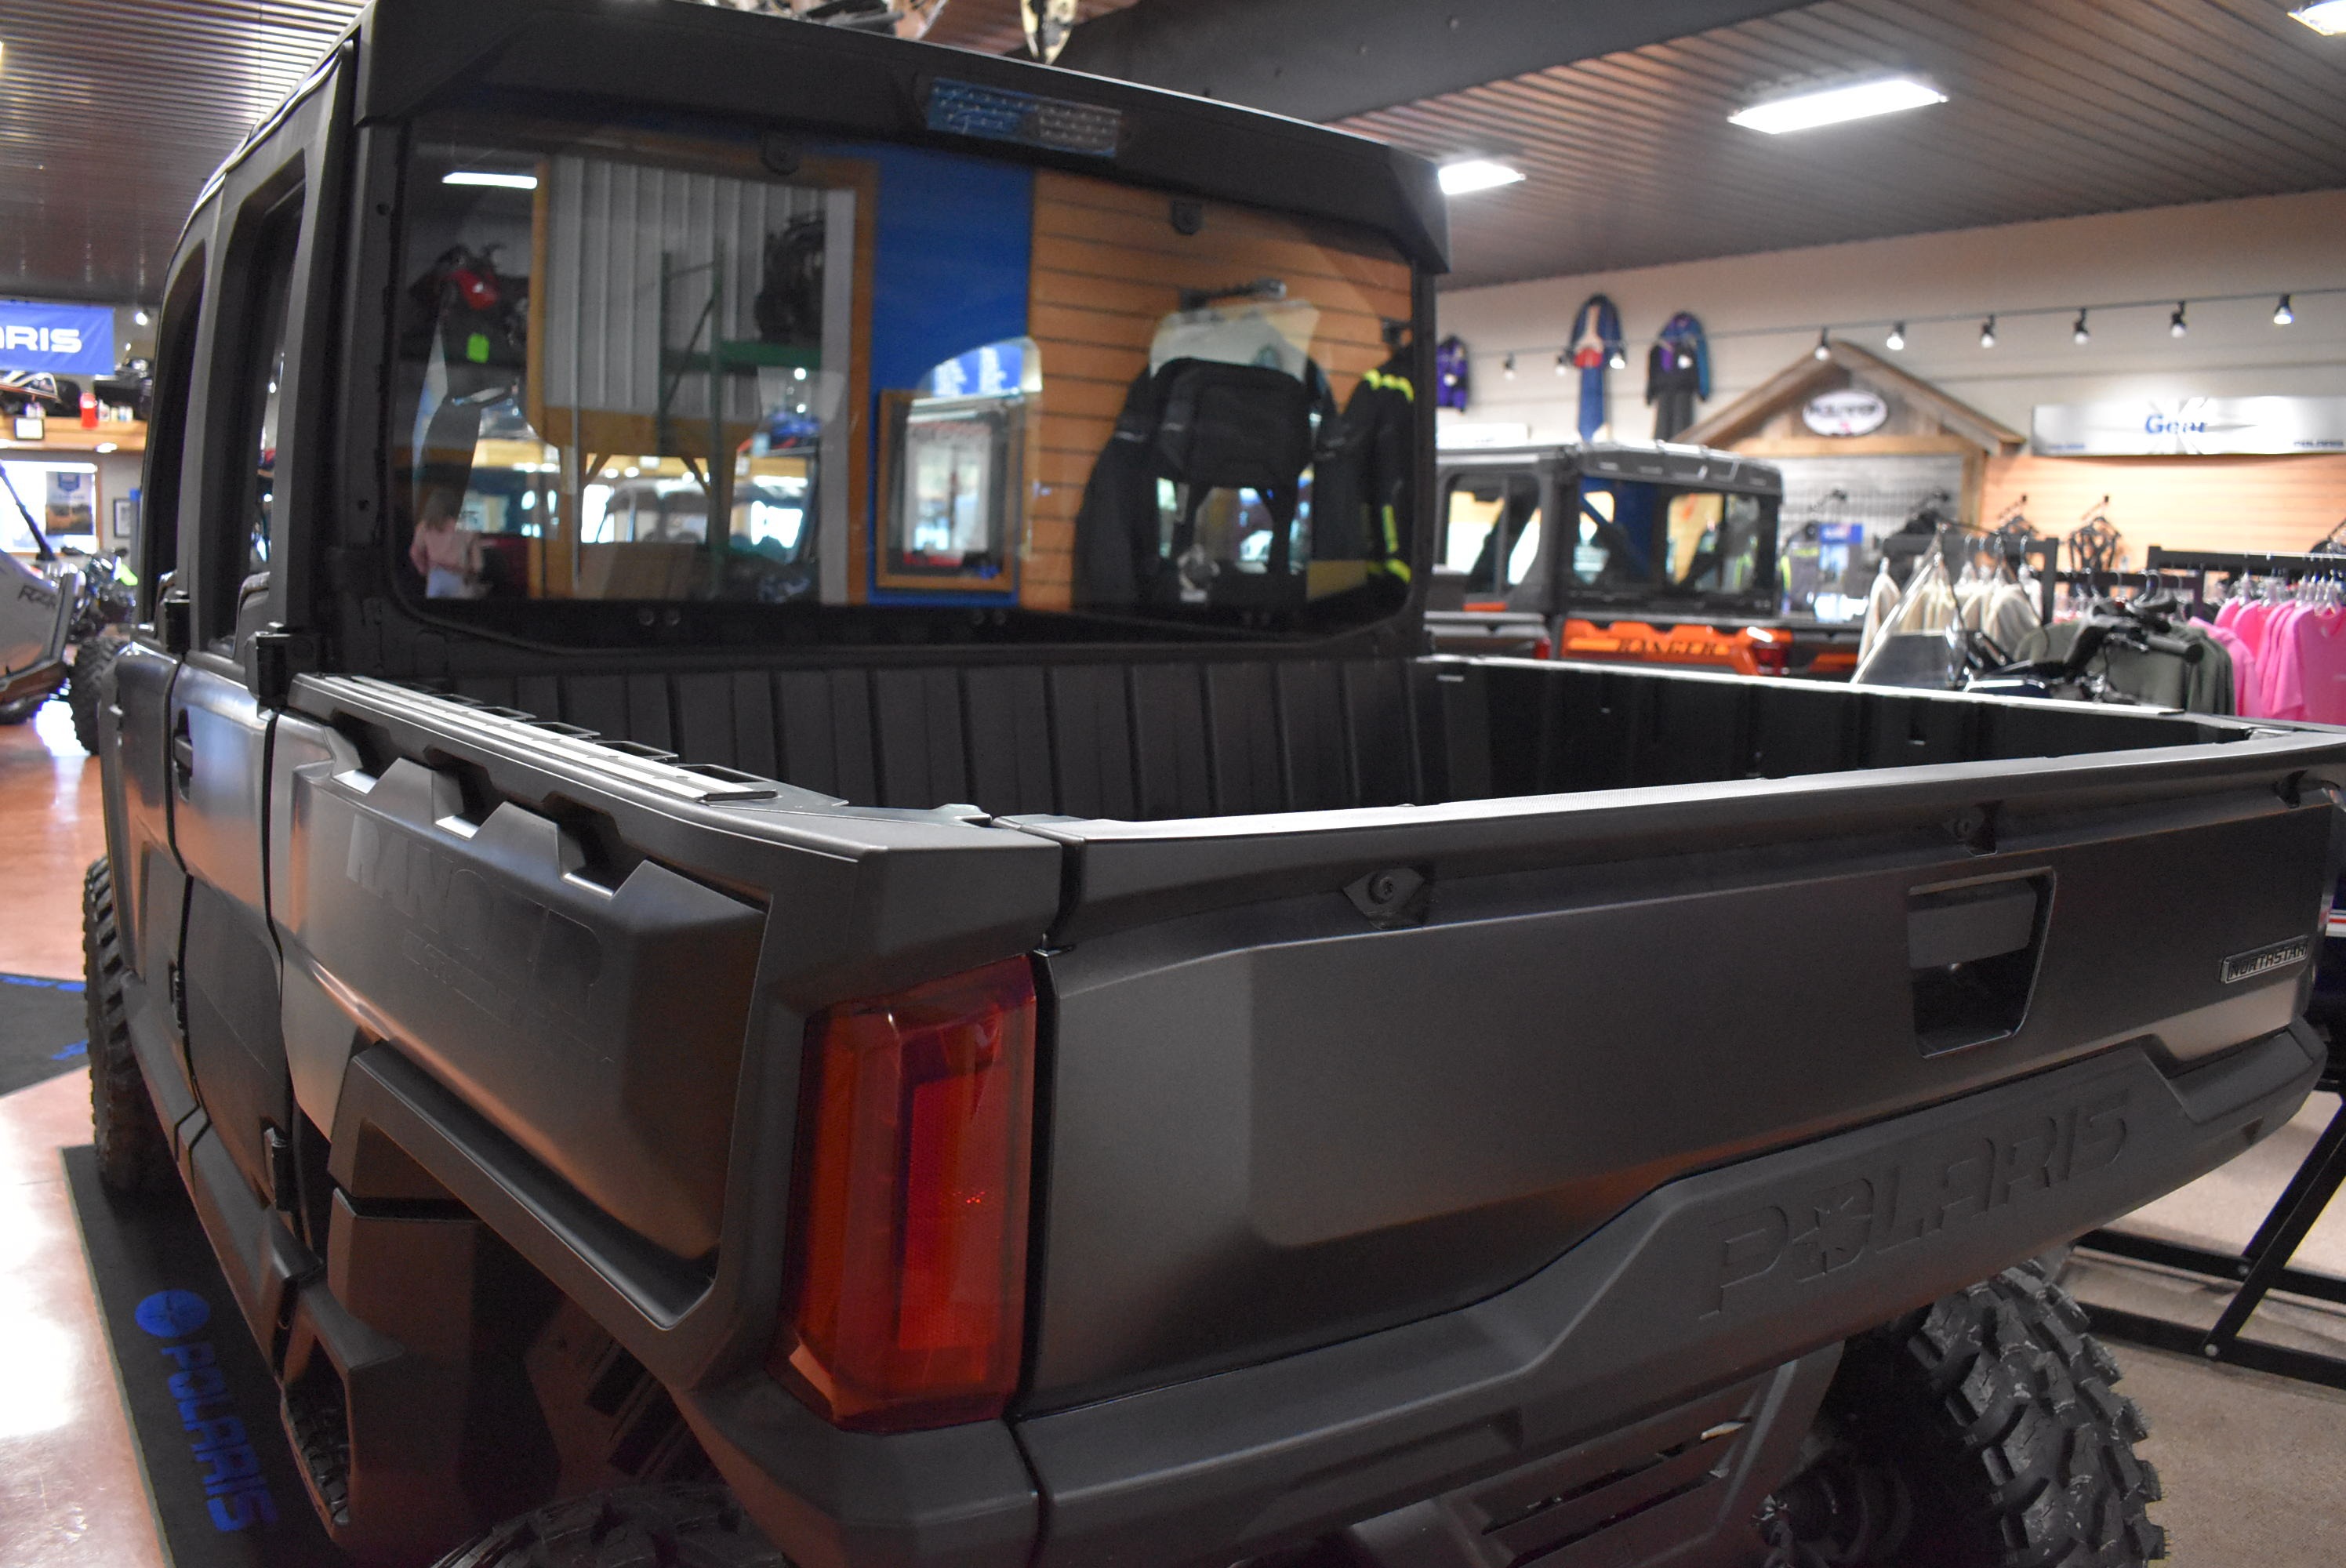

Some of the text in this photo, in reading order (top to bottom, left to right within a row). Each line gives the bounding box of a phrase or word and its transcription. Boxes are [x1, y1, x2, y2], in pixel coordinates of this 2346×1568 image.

[0, 325, 82, 354] RIS
[1698, 1094, 2127, 1319] POLARIS
[161, 1342, 278, 1531] POLARIS
